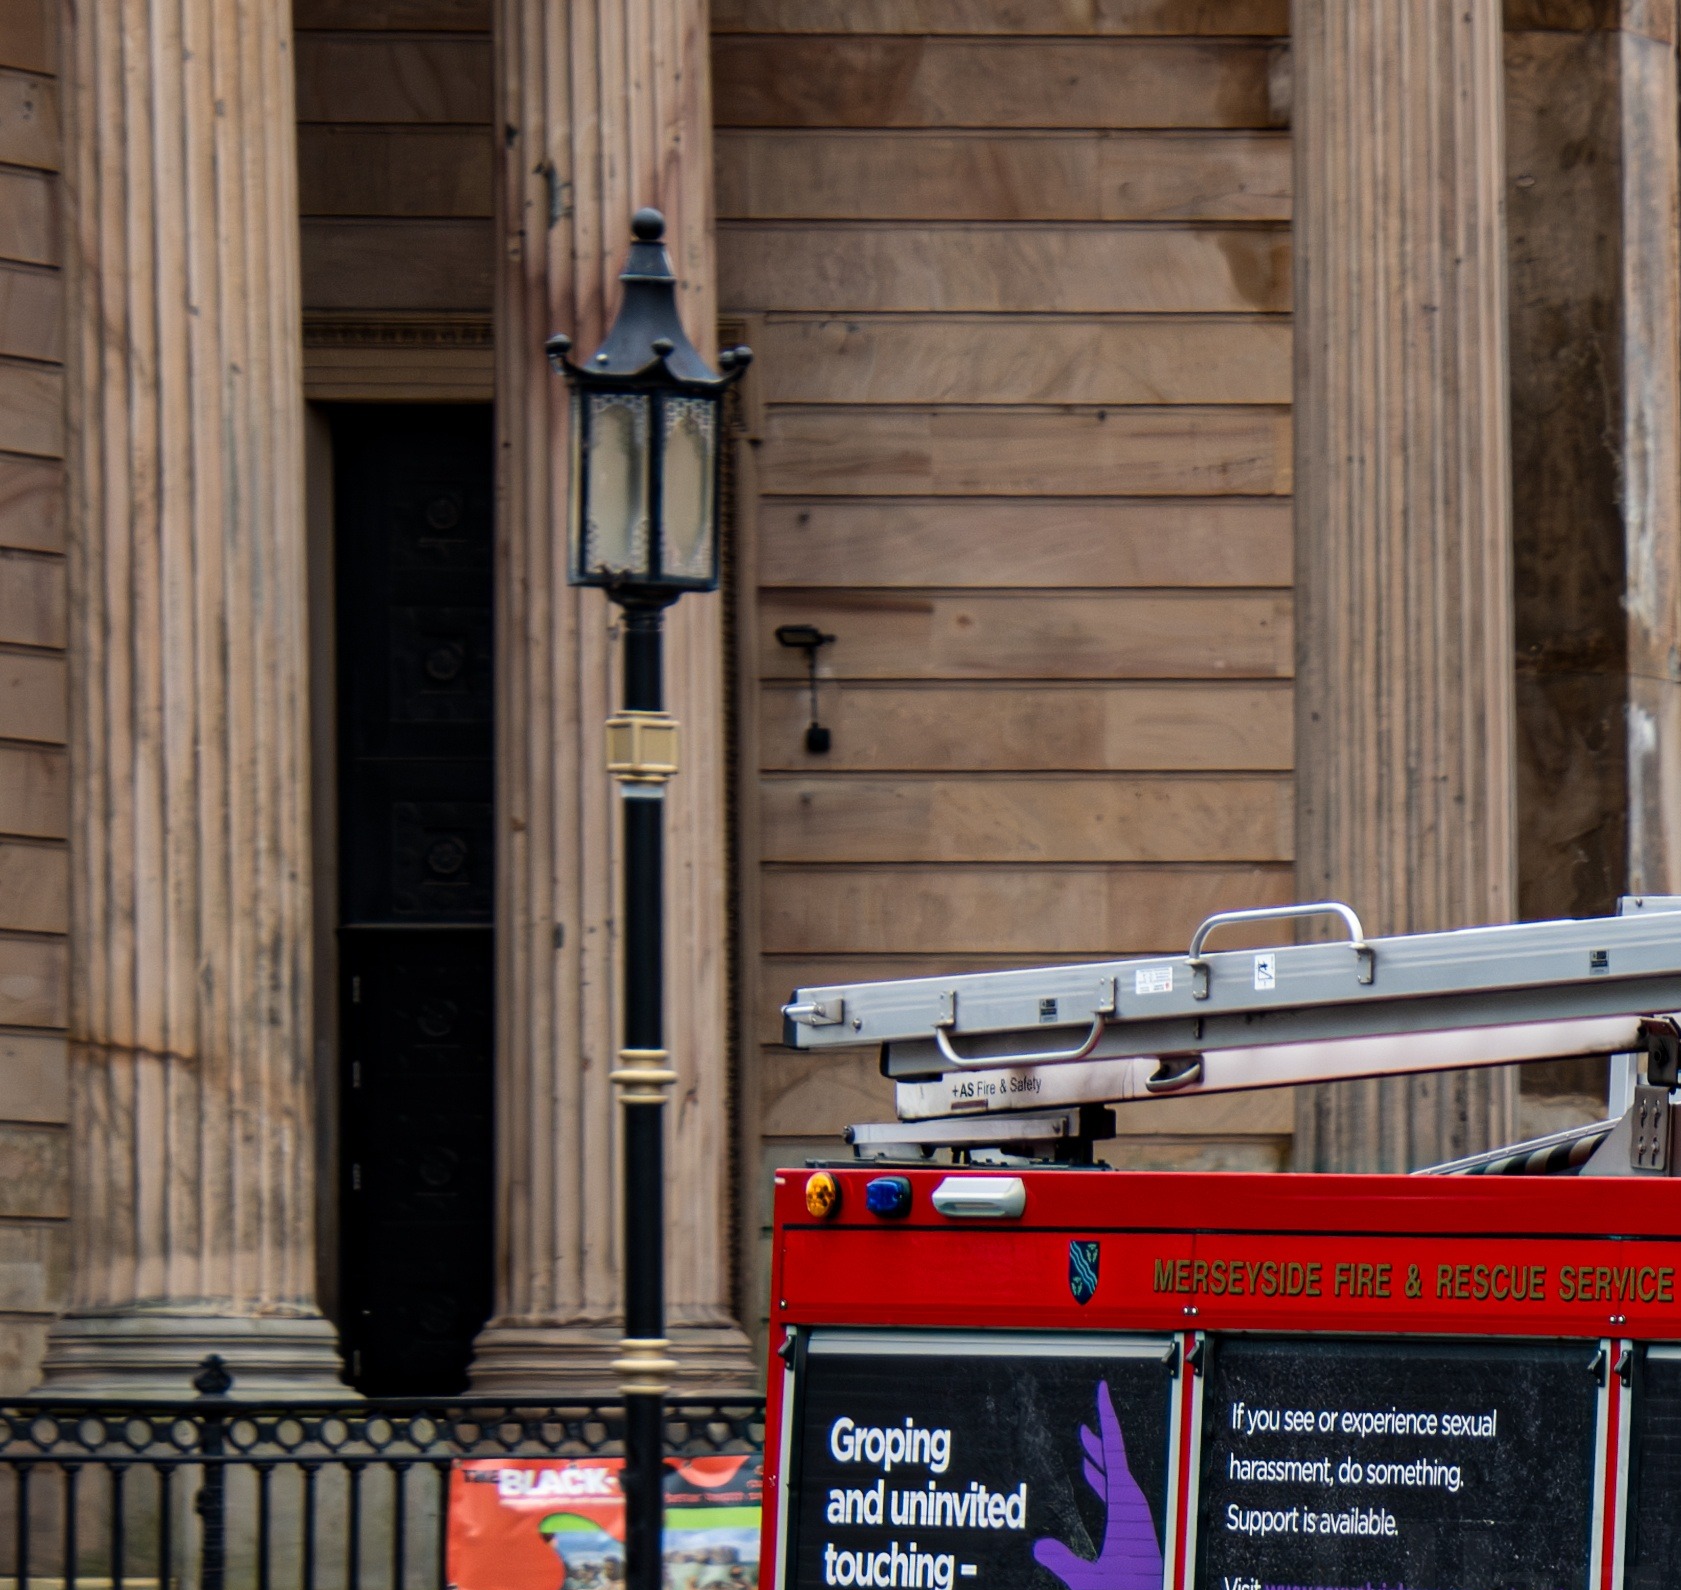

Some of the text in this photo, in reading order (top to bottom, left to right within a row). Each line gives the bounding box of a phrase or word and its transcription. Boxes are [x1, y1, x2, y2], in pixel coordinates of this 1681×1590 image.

[976, 1080, 996, 1097] Fire
[1000, 1078, 1007, 1094] &
[1009, 1075, 1042, 1094] Safety
[1152, 1257, 1675, 1302] MERSEYSIDE FIRE & RESCUE SERVICE
[1232, 1402, 1498, 1438] If you see or experience sexual
[830, 1417, 952, 1474] Groping
[498, 1467, 618, 1496] BLACK-
[1229, 1452, 1464, 1493] harassment, do something.
[827, 1478, 1028, 1529] and uninvited
[1226, 1503, 1399, 1537] Support is available.
